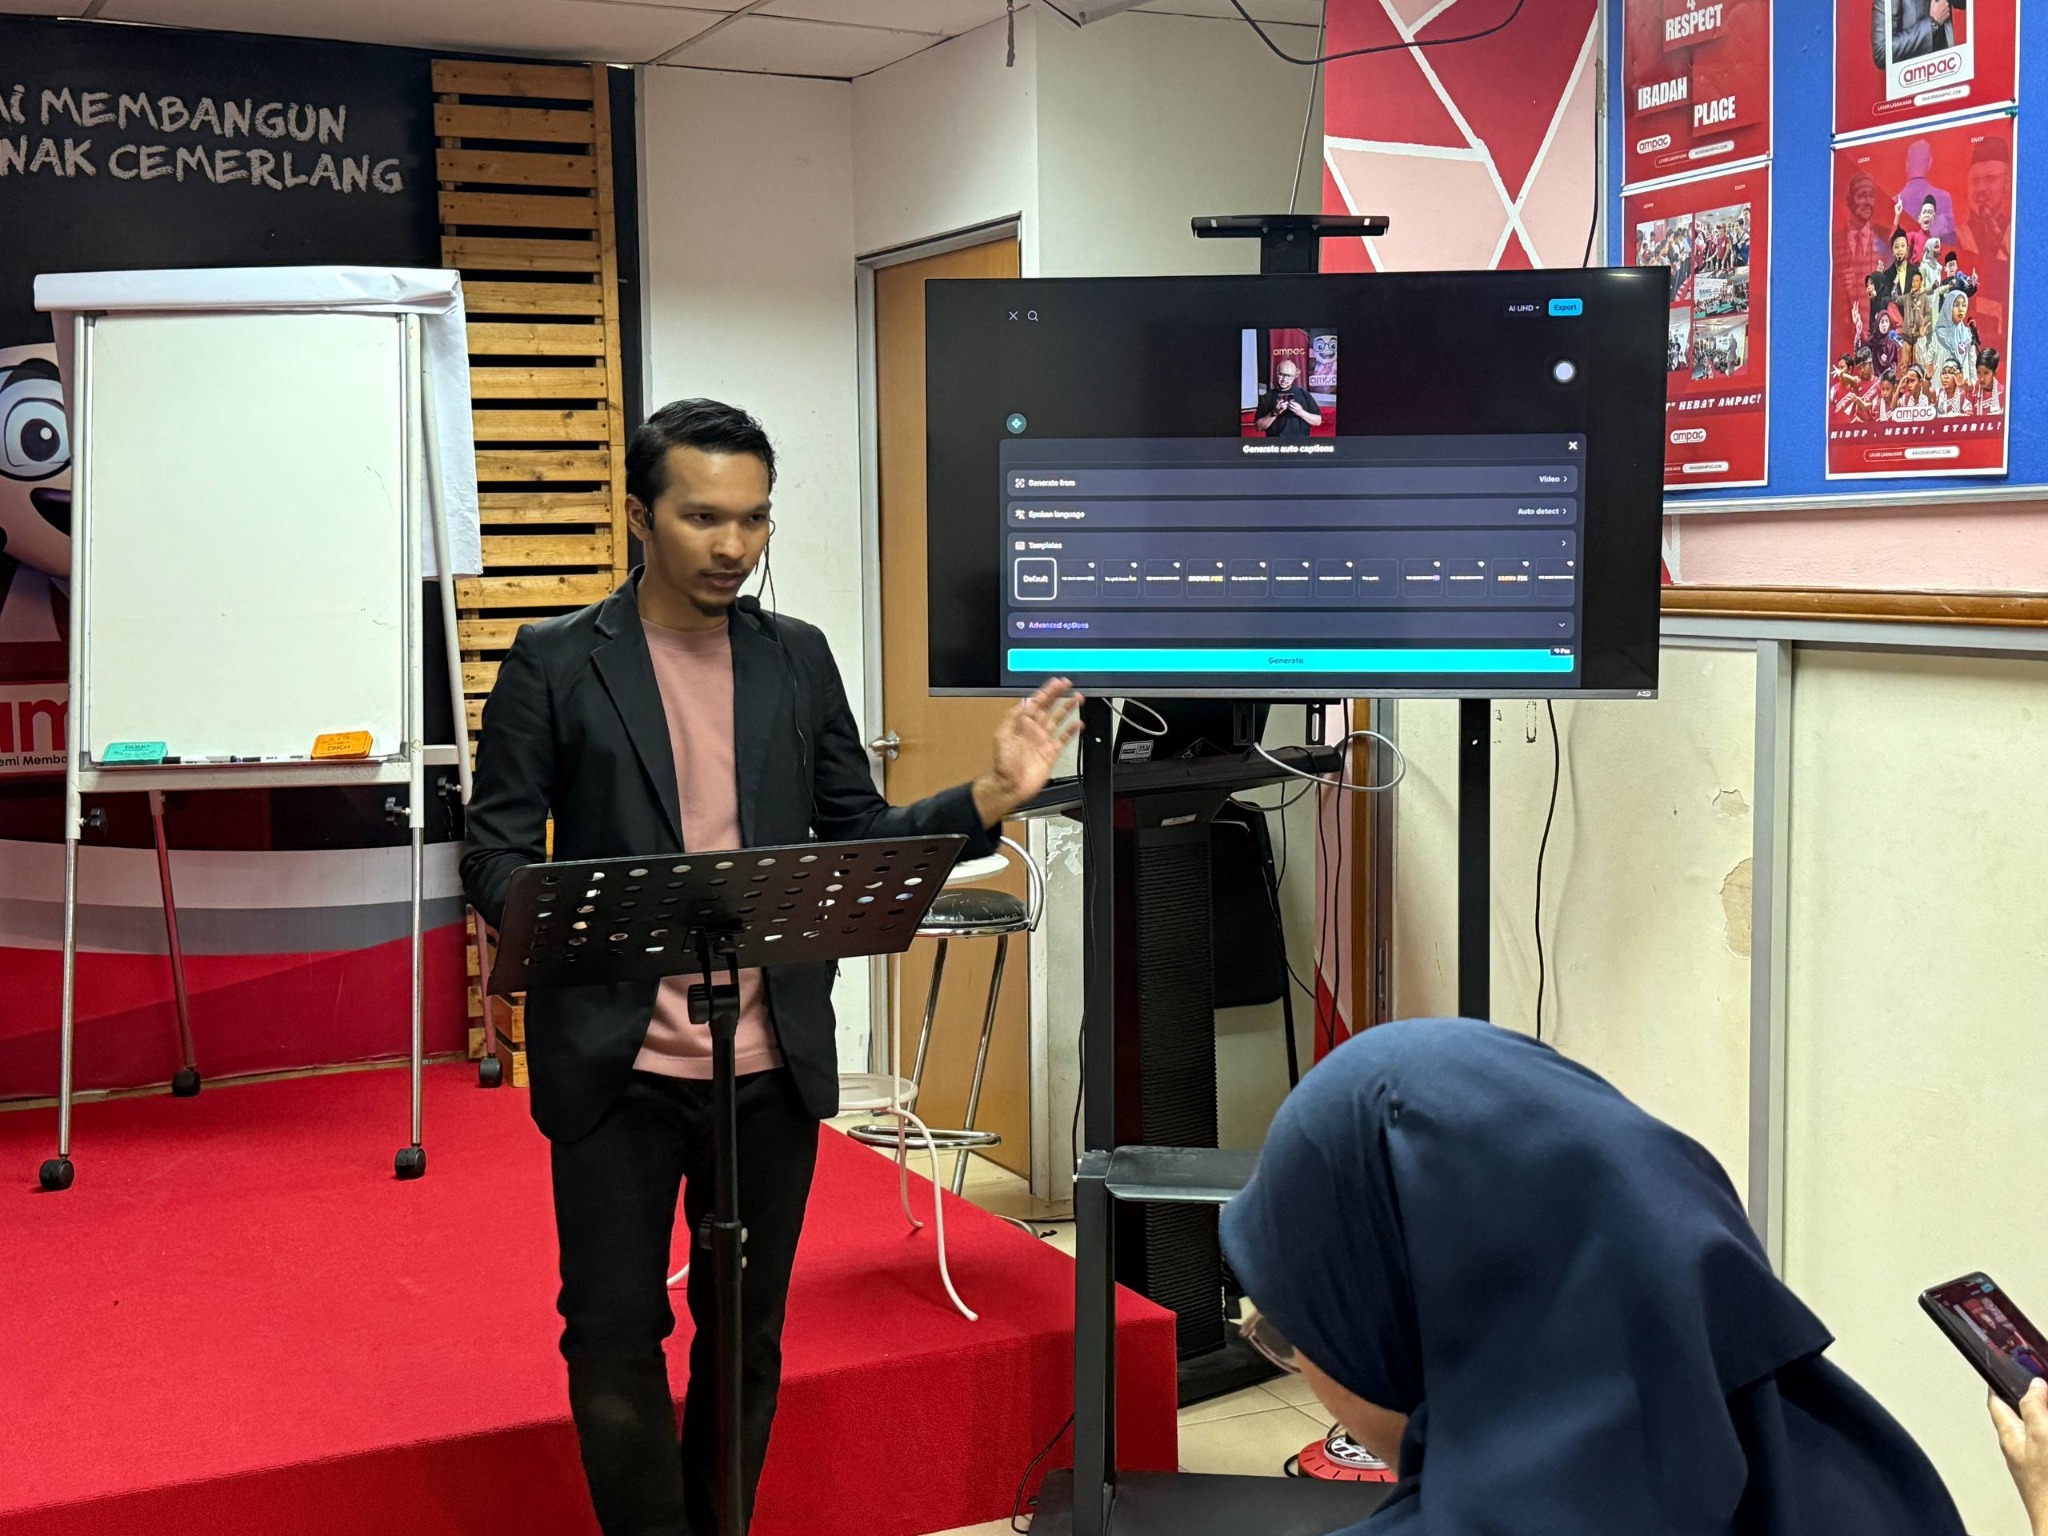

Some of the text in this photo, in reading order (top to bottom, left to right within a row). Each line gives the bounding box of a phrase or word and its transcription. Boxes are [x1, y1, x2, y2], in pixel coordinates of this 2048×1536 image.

[1665, 3, 1724, 42] RESPECT
[1903, 56, 1957, 82] ampac
[1638, 76, 1688, 111] IBADAH
[41, 87, 346, 144] MEMBANGUN
[1693, 95, 1737, 128] PLACE
[1639, 136, 1669, 154] ampac
[109, 144, 404, 194] CEMERLANG
[1517, 304, 1534, 312] UHD
[1554, 304, 1577, 312] Export
[1678, 399, 1715, 411] HEBAT
[1718, 393, 1762, 407] AMPAC!
[1895, 407, 1933, 421] ampac
[1673, 431, 1704, 443] ampac
[1885, 426, 1926, 436] MESTI
[1943, 422, 2002, 433] STABIL!
[1242, 445, 1334, 454] Generate auto captions
[1539, 475, 1560, 483] Video
